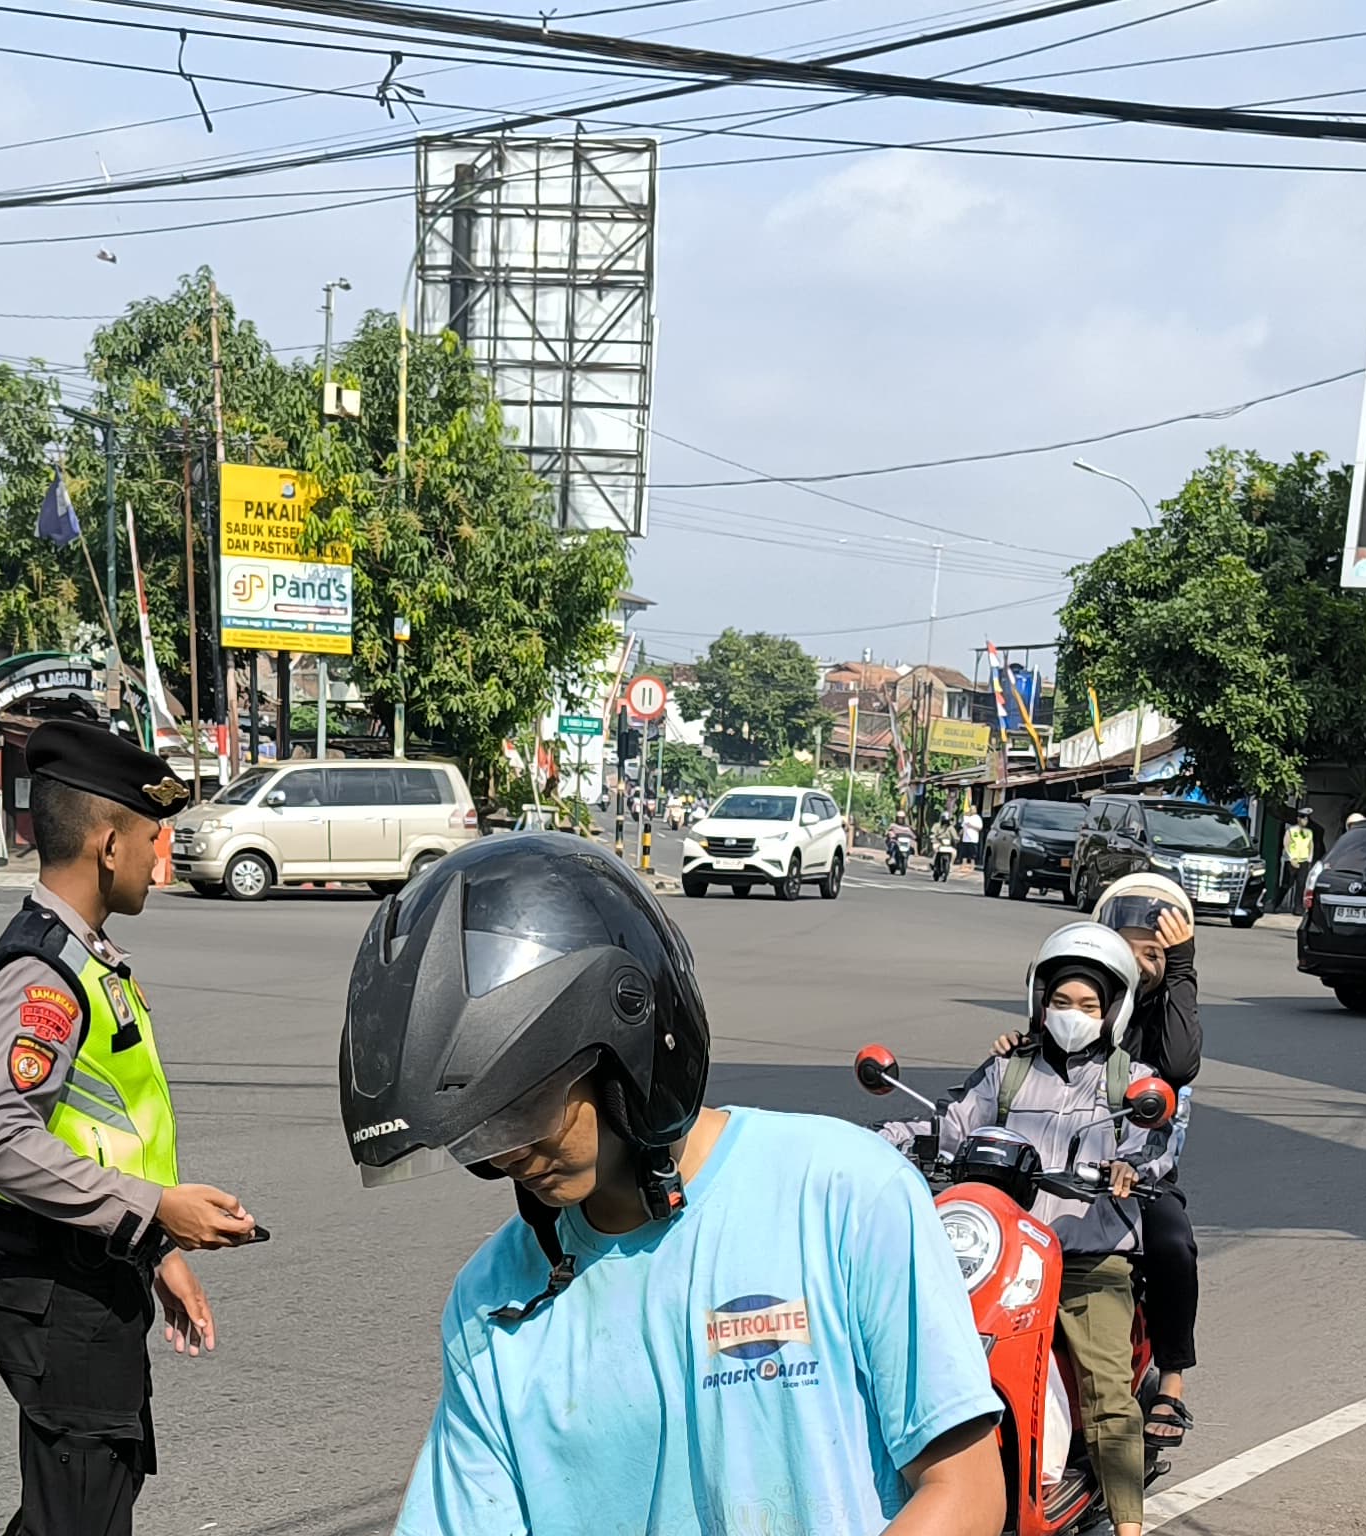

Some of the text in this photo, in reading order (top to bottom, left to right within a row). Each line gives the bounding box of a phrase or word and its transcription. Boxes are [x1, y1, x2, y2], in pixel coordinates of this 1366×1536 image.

[244, 500, 306, 523] PAKAIL
[226, 522, 264, 537] SABUK
[226, 538, 250, 552] DAN
[272, 573, 348, 603] Pand's
[37, 670, 87, 689] JLAGRAN
[352, 1118, 411, 1145] HONDA
[706, 1310, 807, 1341] METROLITE
[702, 1367, 756, 1390] PACIFIC
